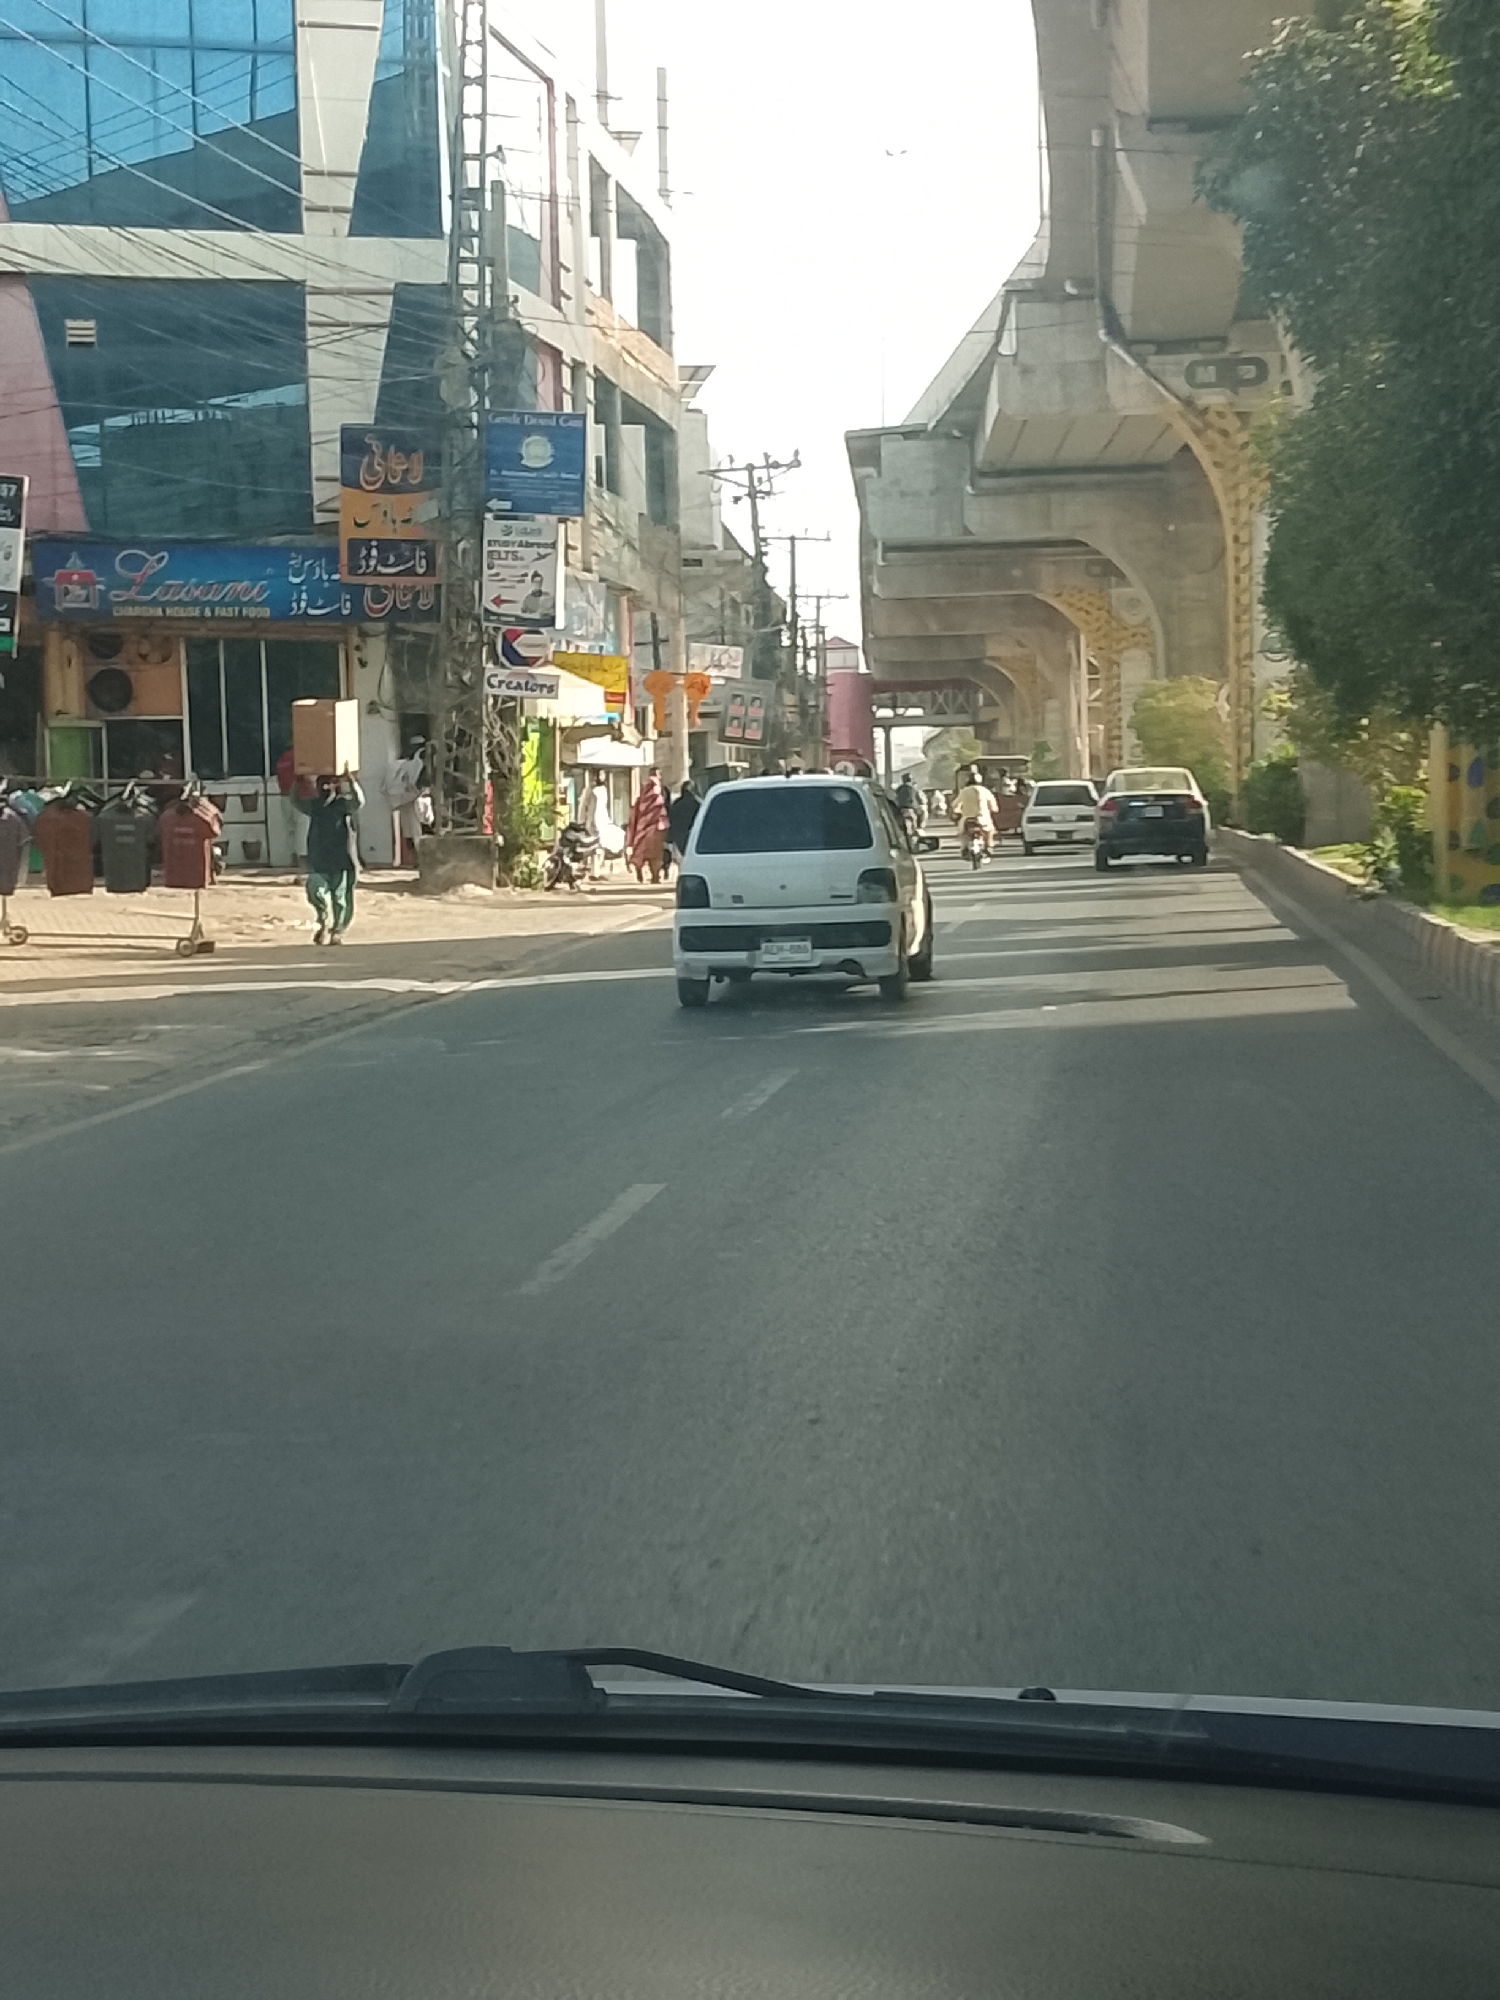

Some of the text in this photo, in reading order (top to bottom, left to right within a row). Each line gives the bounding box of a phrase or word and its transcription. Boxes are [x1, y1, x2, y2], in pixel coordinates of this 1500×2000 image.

[165, 606, 202, 617] HOUSE
[215, 606, 241, 618] FAST
[242, 607, 270, 619] FOOD
